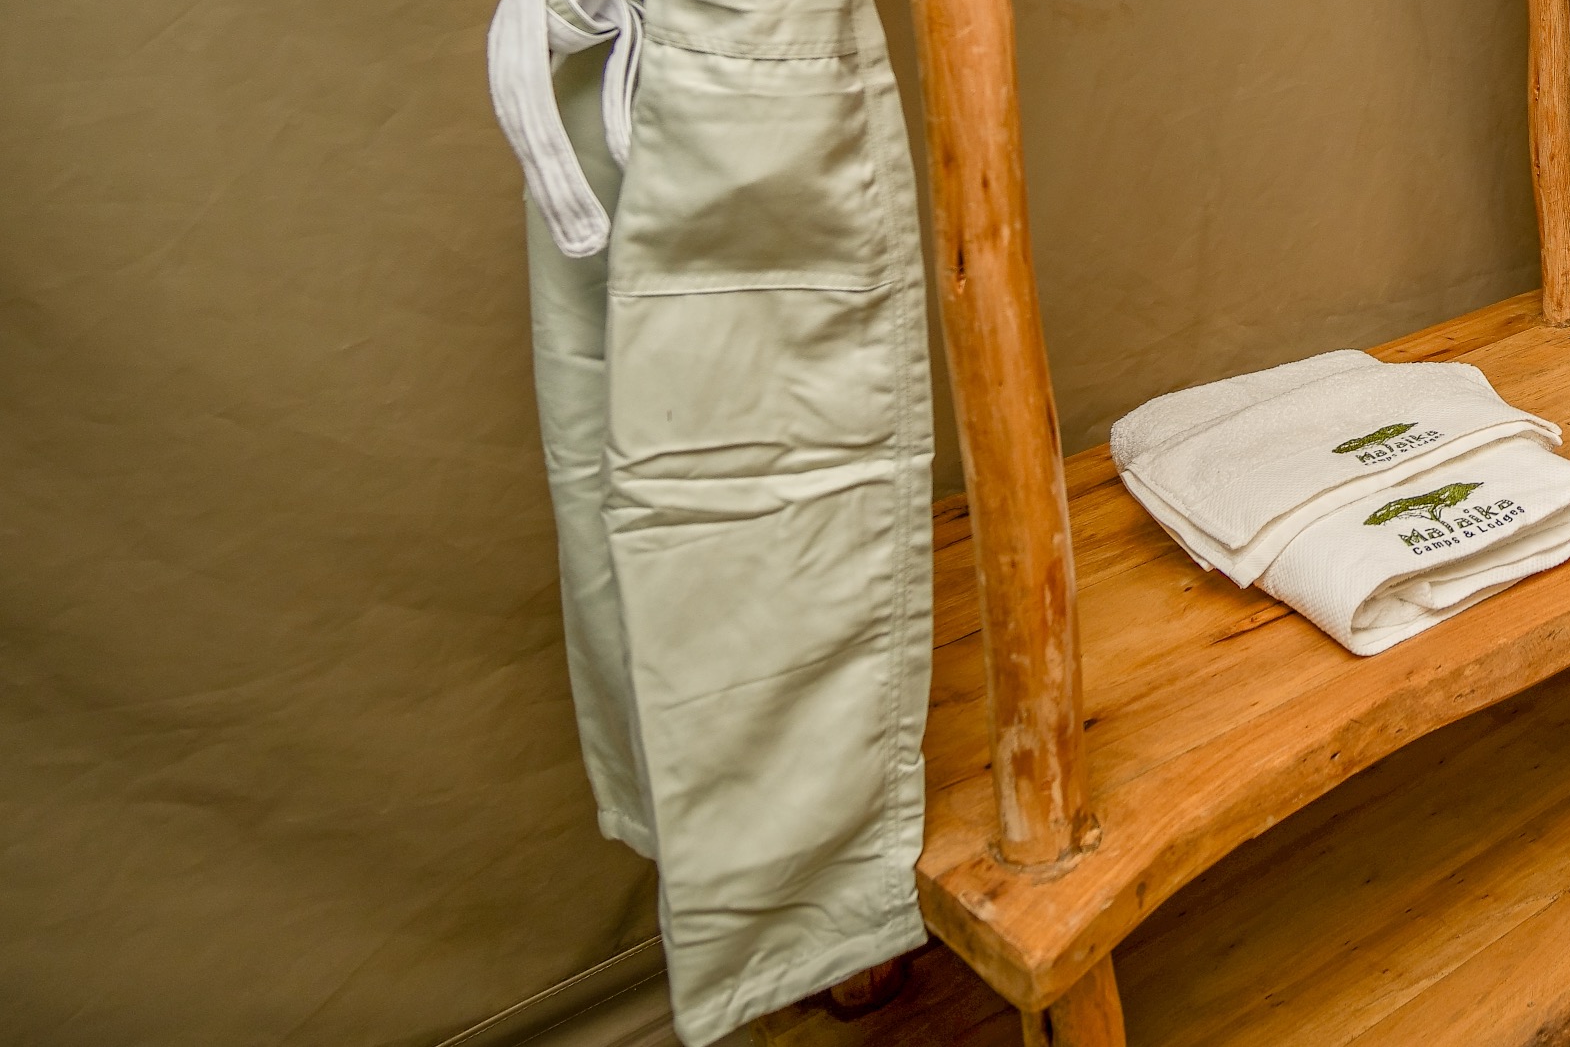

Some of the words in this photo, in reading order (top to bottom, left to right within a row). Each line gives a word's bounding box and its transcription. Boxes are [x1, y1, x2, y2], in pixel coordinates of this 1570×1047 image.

[1355, 430, 1439, 464] Malaika
[1398, 499, 1515, 547] Malaika
[1412, 536, 1460, 556] Camps
[1463, 530, 1476, 539] &
[1476, 505, 1525, 534] Lodges
